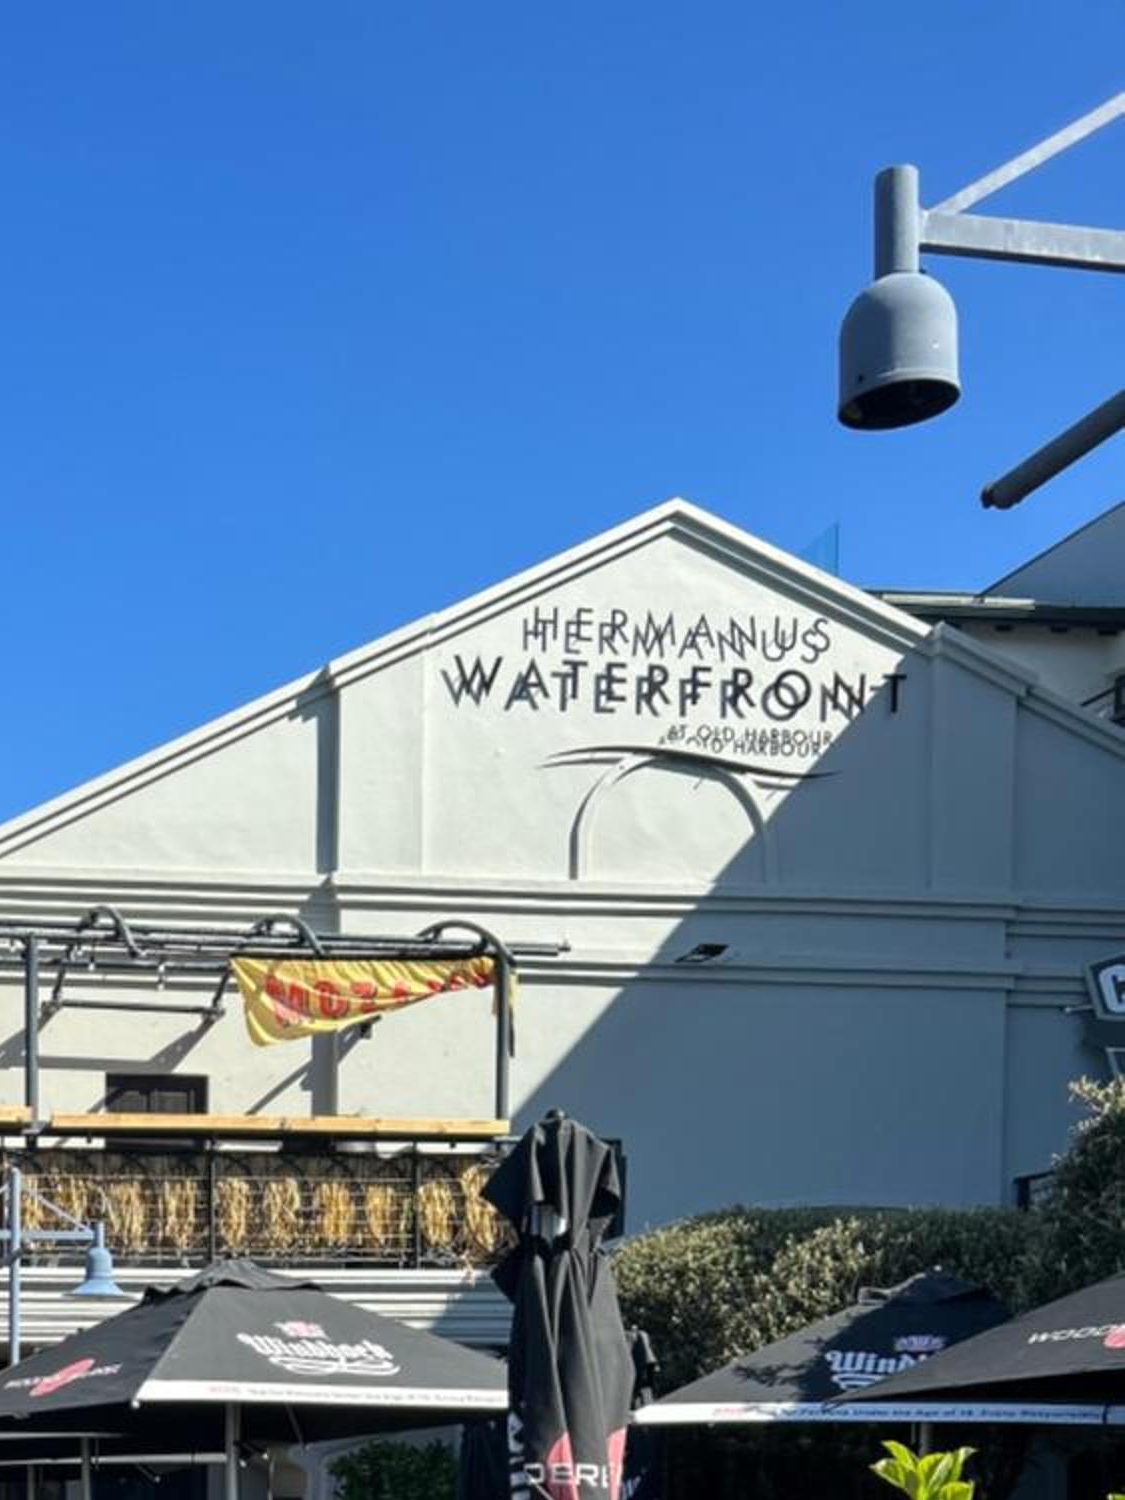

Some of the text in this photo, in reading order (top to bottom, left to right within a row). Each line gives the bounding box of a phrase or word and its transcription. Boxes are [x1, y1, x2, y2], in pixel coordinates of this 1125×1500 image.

[531, 606, 832, 656] HERMANUS
[453, 655, 908, 714] WATERFRONT
[697, 725, 735, 743] OLD
[745, 728, 833, 747] HARBOUR
